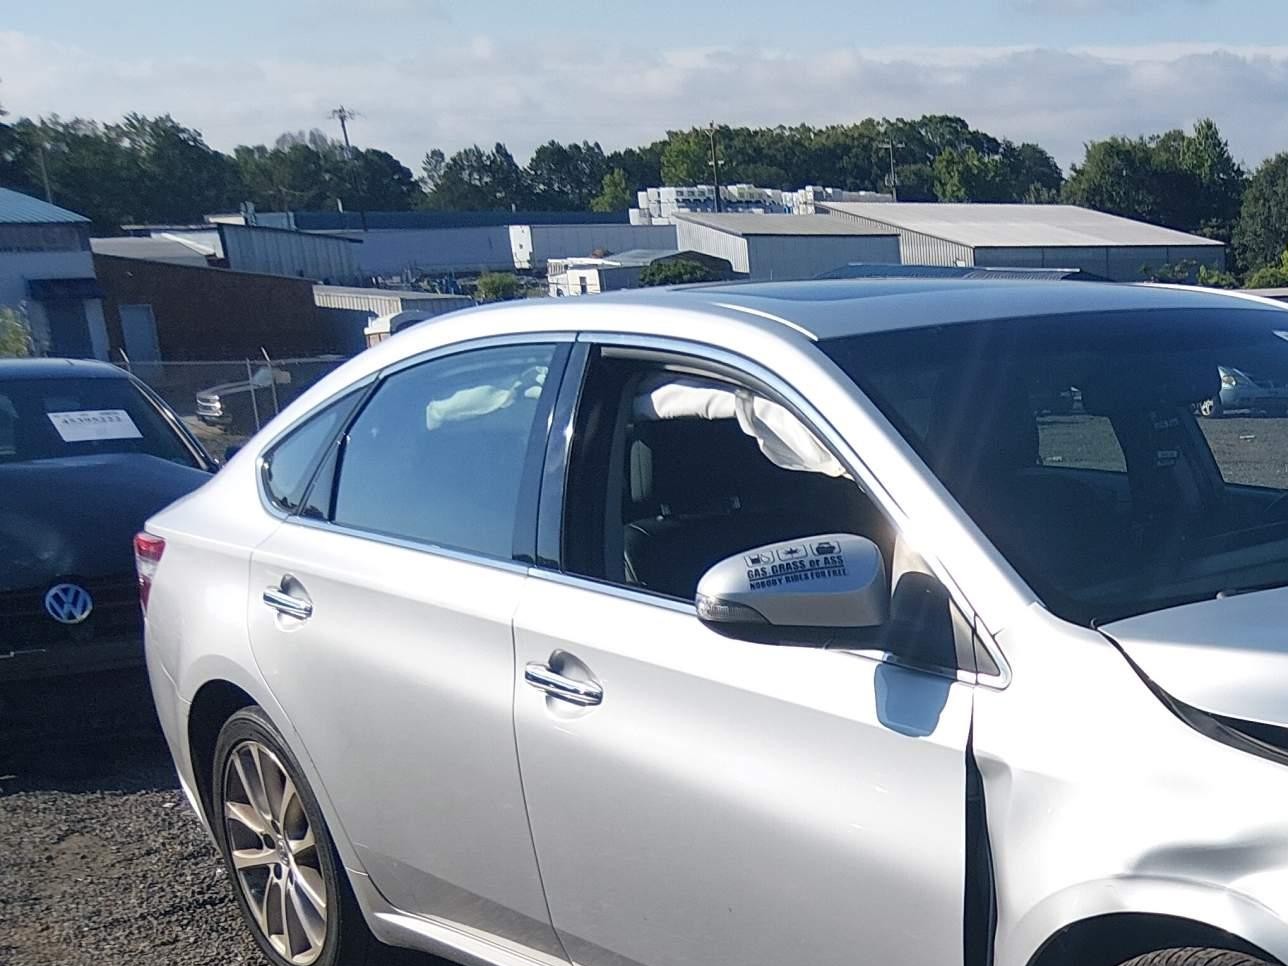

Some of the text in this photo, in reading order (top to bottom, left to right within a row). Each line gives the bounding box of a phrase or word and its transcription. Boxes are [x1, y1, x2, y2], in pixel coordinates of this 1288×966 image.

[772, 560, 805, 574] GRASS
[810, 558, 820, 567] or
[824, 555, 844, 565] ASS
[749, 578, 783, 590] NOBODY
